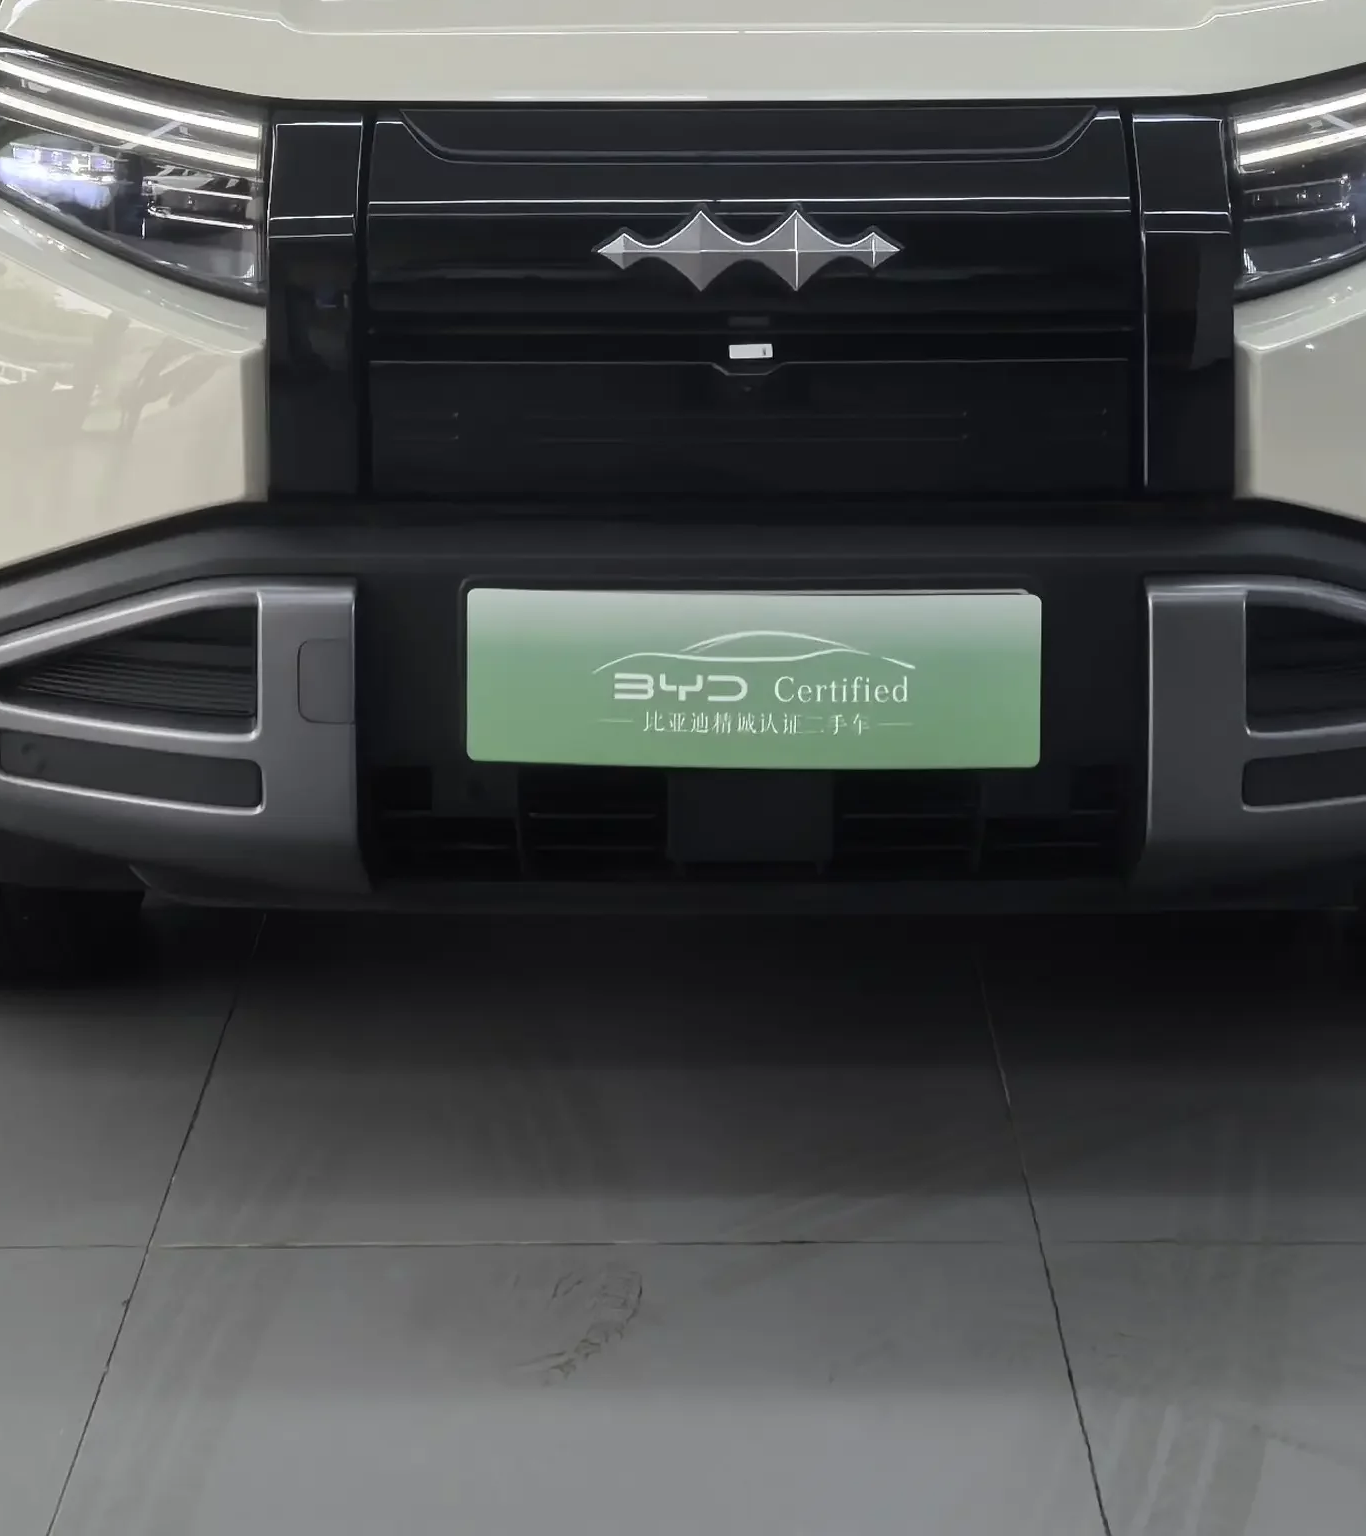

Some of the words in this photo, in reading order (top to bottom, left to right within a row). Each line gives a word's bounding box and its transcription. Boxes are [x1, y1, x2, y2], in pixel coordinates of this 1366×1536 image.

[613, 672, 749, 702] BYD
[773, 675, 909, 704] Certified
[642, 710, 871, 737] 比亚迪精诚认证二手车
